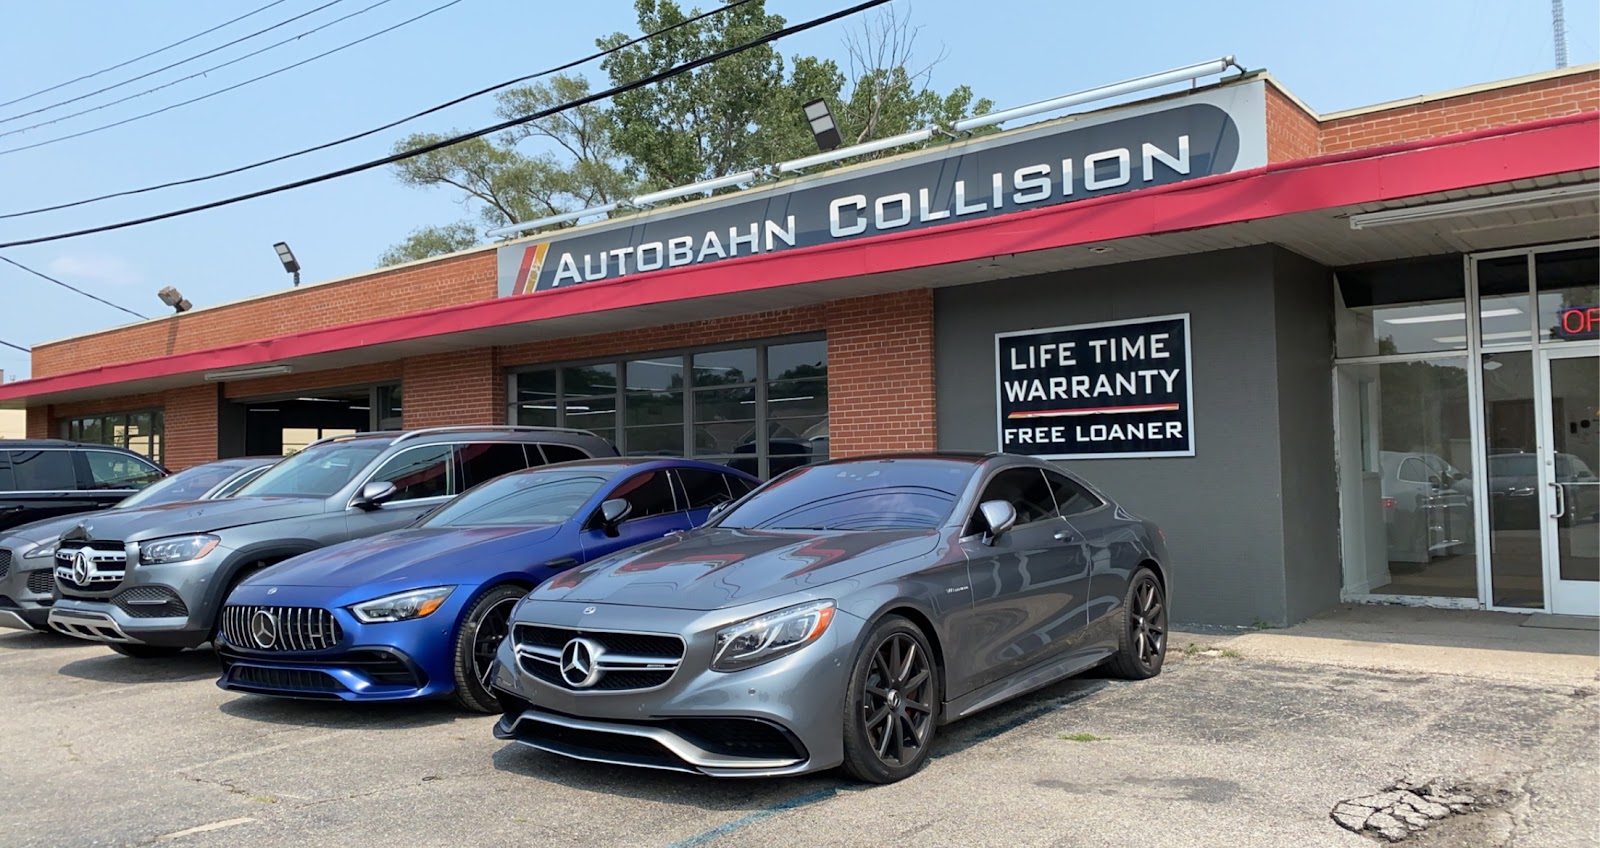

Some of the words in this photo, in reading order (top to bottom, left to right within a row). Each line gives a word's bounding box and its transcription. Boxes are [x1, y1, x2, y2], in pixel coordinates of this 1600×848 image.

[552, 215, 796, 287] AUTOBAHN
[829, 135, 1190, 238] COLLISION
[1011, 342, 1077, 370] LIFE
[1089, 333, 1170, 363] TIME
[1004, 368, 1180, 403] WARRANTY
[1004, 426, 1066, 444] FREE
[1076, 421, 1184, 442] LOANER
